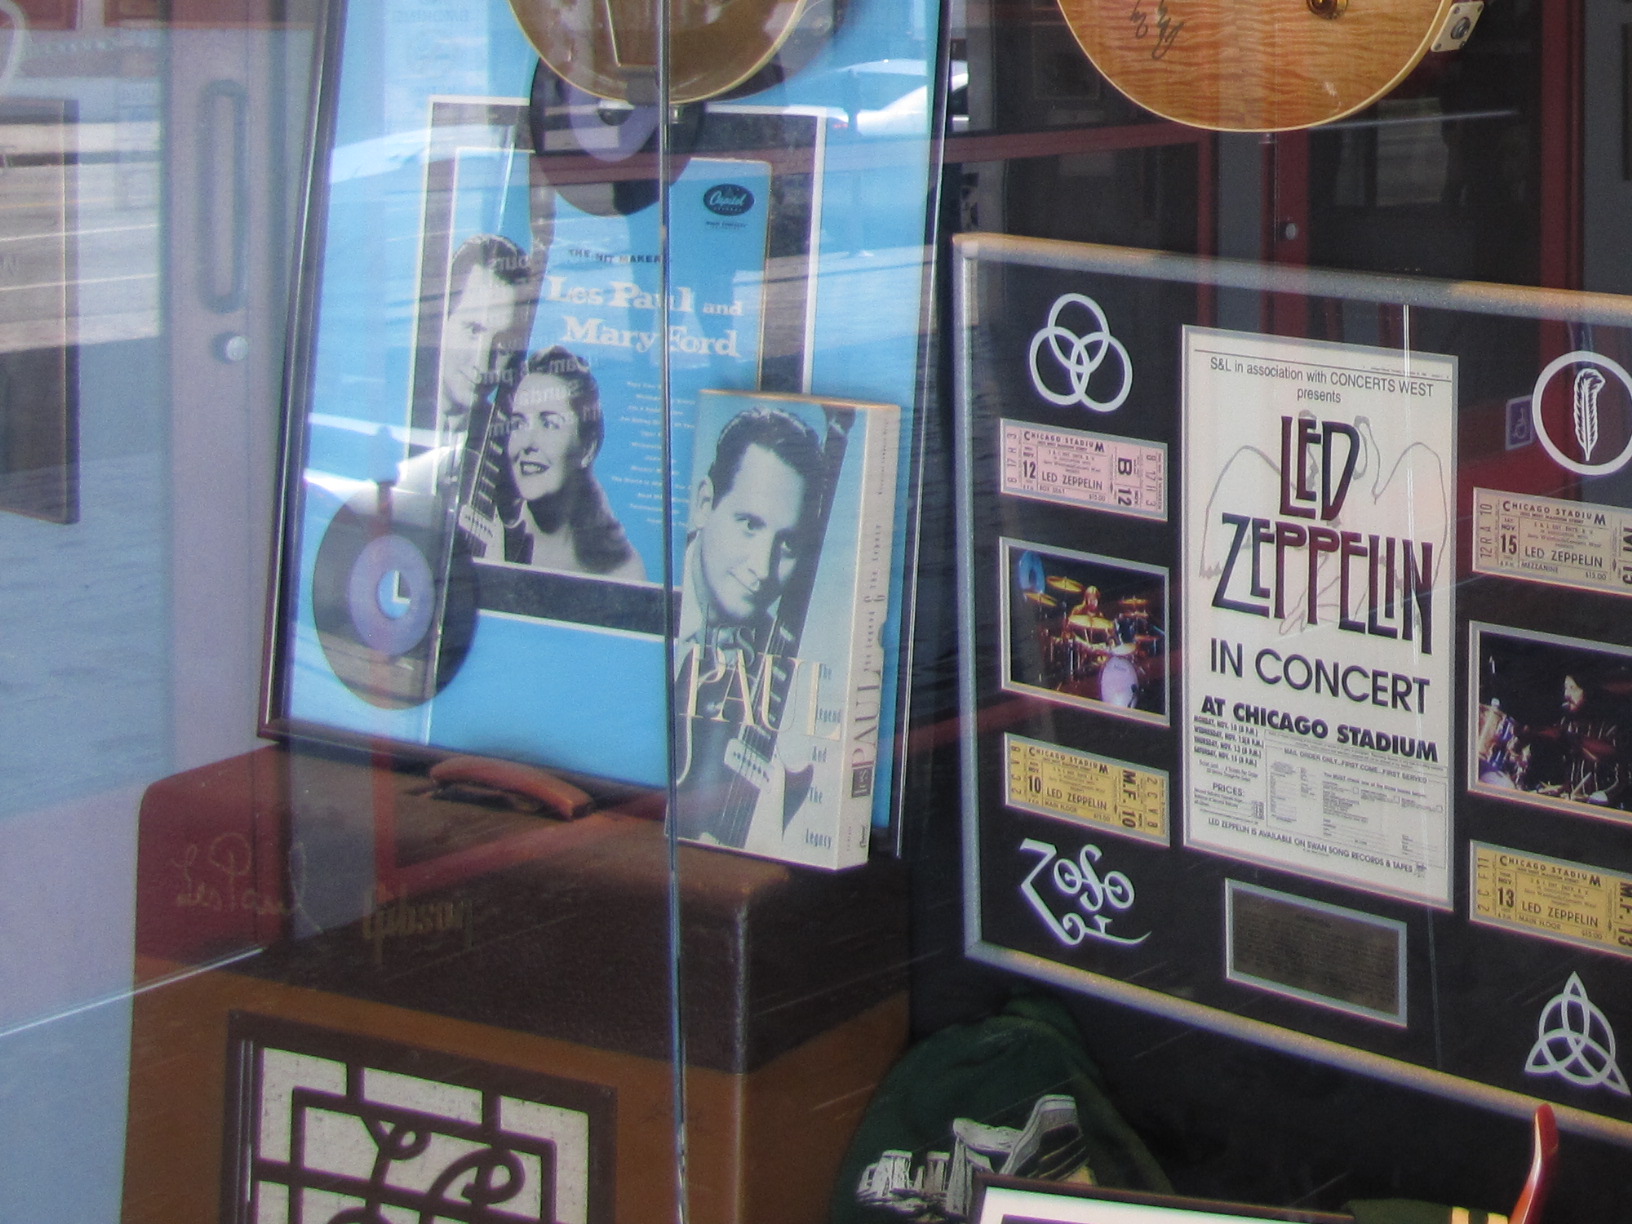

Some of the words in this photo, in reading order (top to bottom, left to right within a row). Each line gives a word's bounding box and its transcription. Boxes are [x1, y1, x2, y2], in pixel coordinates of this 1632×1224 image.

[709, 190, 746, 207] Capitol
[568, 248, 591, 258] THE
[596, 254, 613, 264] HIT
[544, 275, 604, 306] Les
[703, 301, 744, 316] and
[560, 316, 658, 353] Mary
[669, 325, 741, 358] Ford
[1210, 357, 1232, 373] S&L
[1235, 359, 1244, 374] in
[1247, 362, 1303, 381] association
[1306, 368, 1327, 384] with
[1330, 371, 1396, 393] CONCERTS
[1399, 380, 1435, 397] WEST
[1297, 387, 1342, 404] presents
[1024, 431, 1061, 443] CHICAGO
[1065, 436, 1105, 453] STADIUM
[1023, 460, 1036, 479] 12
[1117, 457, 1133, 477] B
[1279, 415, 1361, 521] LED
[1041, 471, 1058, 483] LED
[1062, 475, 1103, 491] ZEPPELIN
[1118, 487, 1132, 506] 12
[1503, 500, 1550, 514] CHICAGO
[1556, 508, 1606, 526] STADIUM
[1500, 533, 1517, 555] 15
[1524, 545, 1545, 559] LED
[1551, 549, 1603, 568] ZEPPELIN
[1211, 512, 1434, 656] ZEPPELIN
[819, 662, 833, 679] The
[1211, 637, 1243, 678] IN
[1255, 647, 1431, 715] CONCERT
[678, 643, 847, 741] PAUL
[816, 708, 842, 726] Legend
[1201, 695, 1226, 716] AT
[1233, 702, 1329, 739] CHICAGO
[1337, 724, 1439, 763] STADIUM
[811, 745, 828, 763] And
[1028, 747, 1065, 761] CHICAGO
[1070, 756, 1108, 774] STADIUM
[1300, 751, 1320, 761] ORDER
[808, 787, 823, 804] The
[1028, 775, 1041, 794] 10
[1122, 770, 1136, 803] M.F.
[1047, 787, 1062, 799] LED
[1067, 791, 1107, 811] ZEPPELIN
[1122, 810, 1136, 828] 10
[805, 828, 832, 850] Legacy
[1208, 817, 1220, 827] LED
[1222, 820, 1250, 834] ZEPPELIN
[1251, 826, 1257, 836] IS
[1258, 828, 1292, 845] AVAILABLE
[1294, 836, 1306, 846] ON
[1307, 840, 1327, 853] SWAN
[1328, 845, 1350, 858] SONG
[1351, 851, 1384, 866] RECORDS
[1392, 860, 1413, 873] TAPES
[1500, 855, 1546, 871] CHICAGO
[1551, 866, 1601, 887] STADIUM
[1498, 887, 1515, 909] 13
[1522, 901, 1541, 914] LED
[1548, 906, 1599, 927] ZEPPELIN
